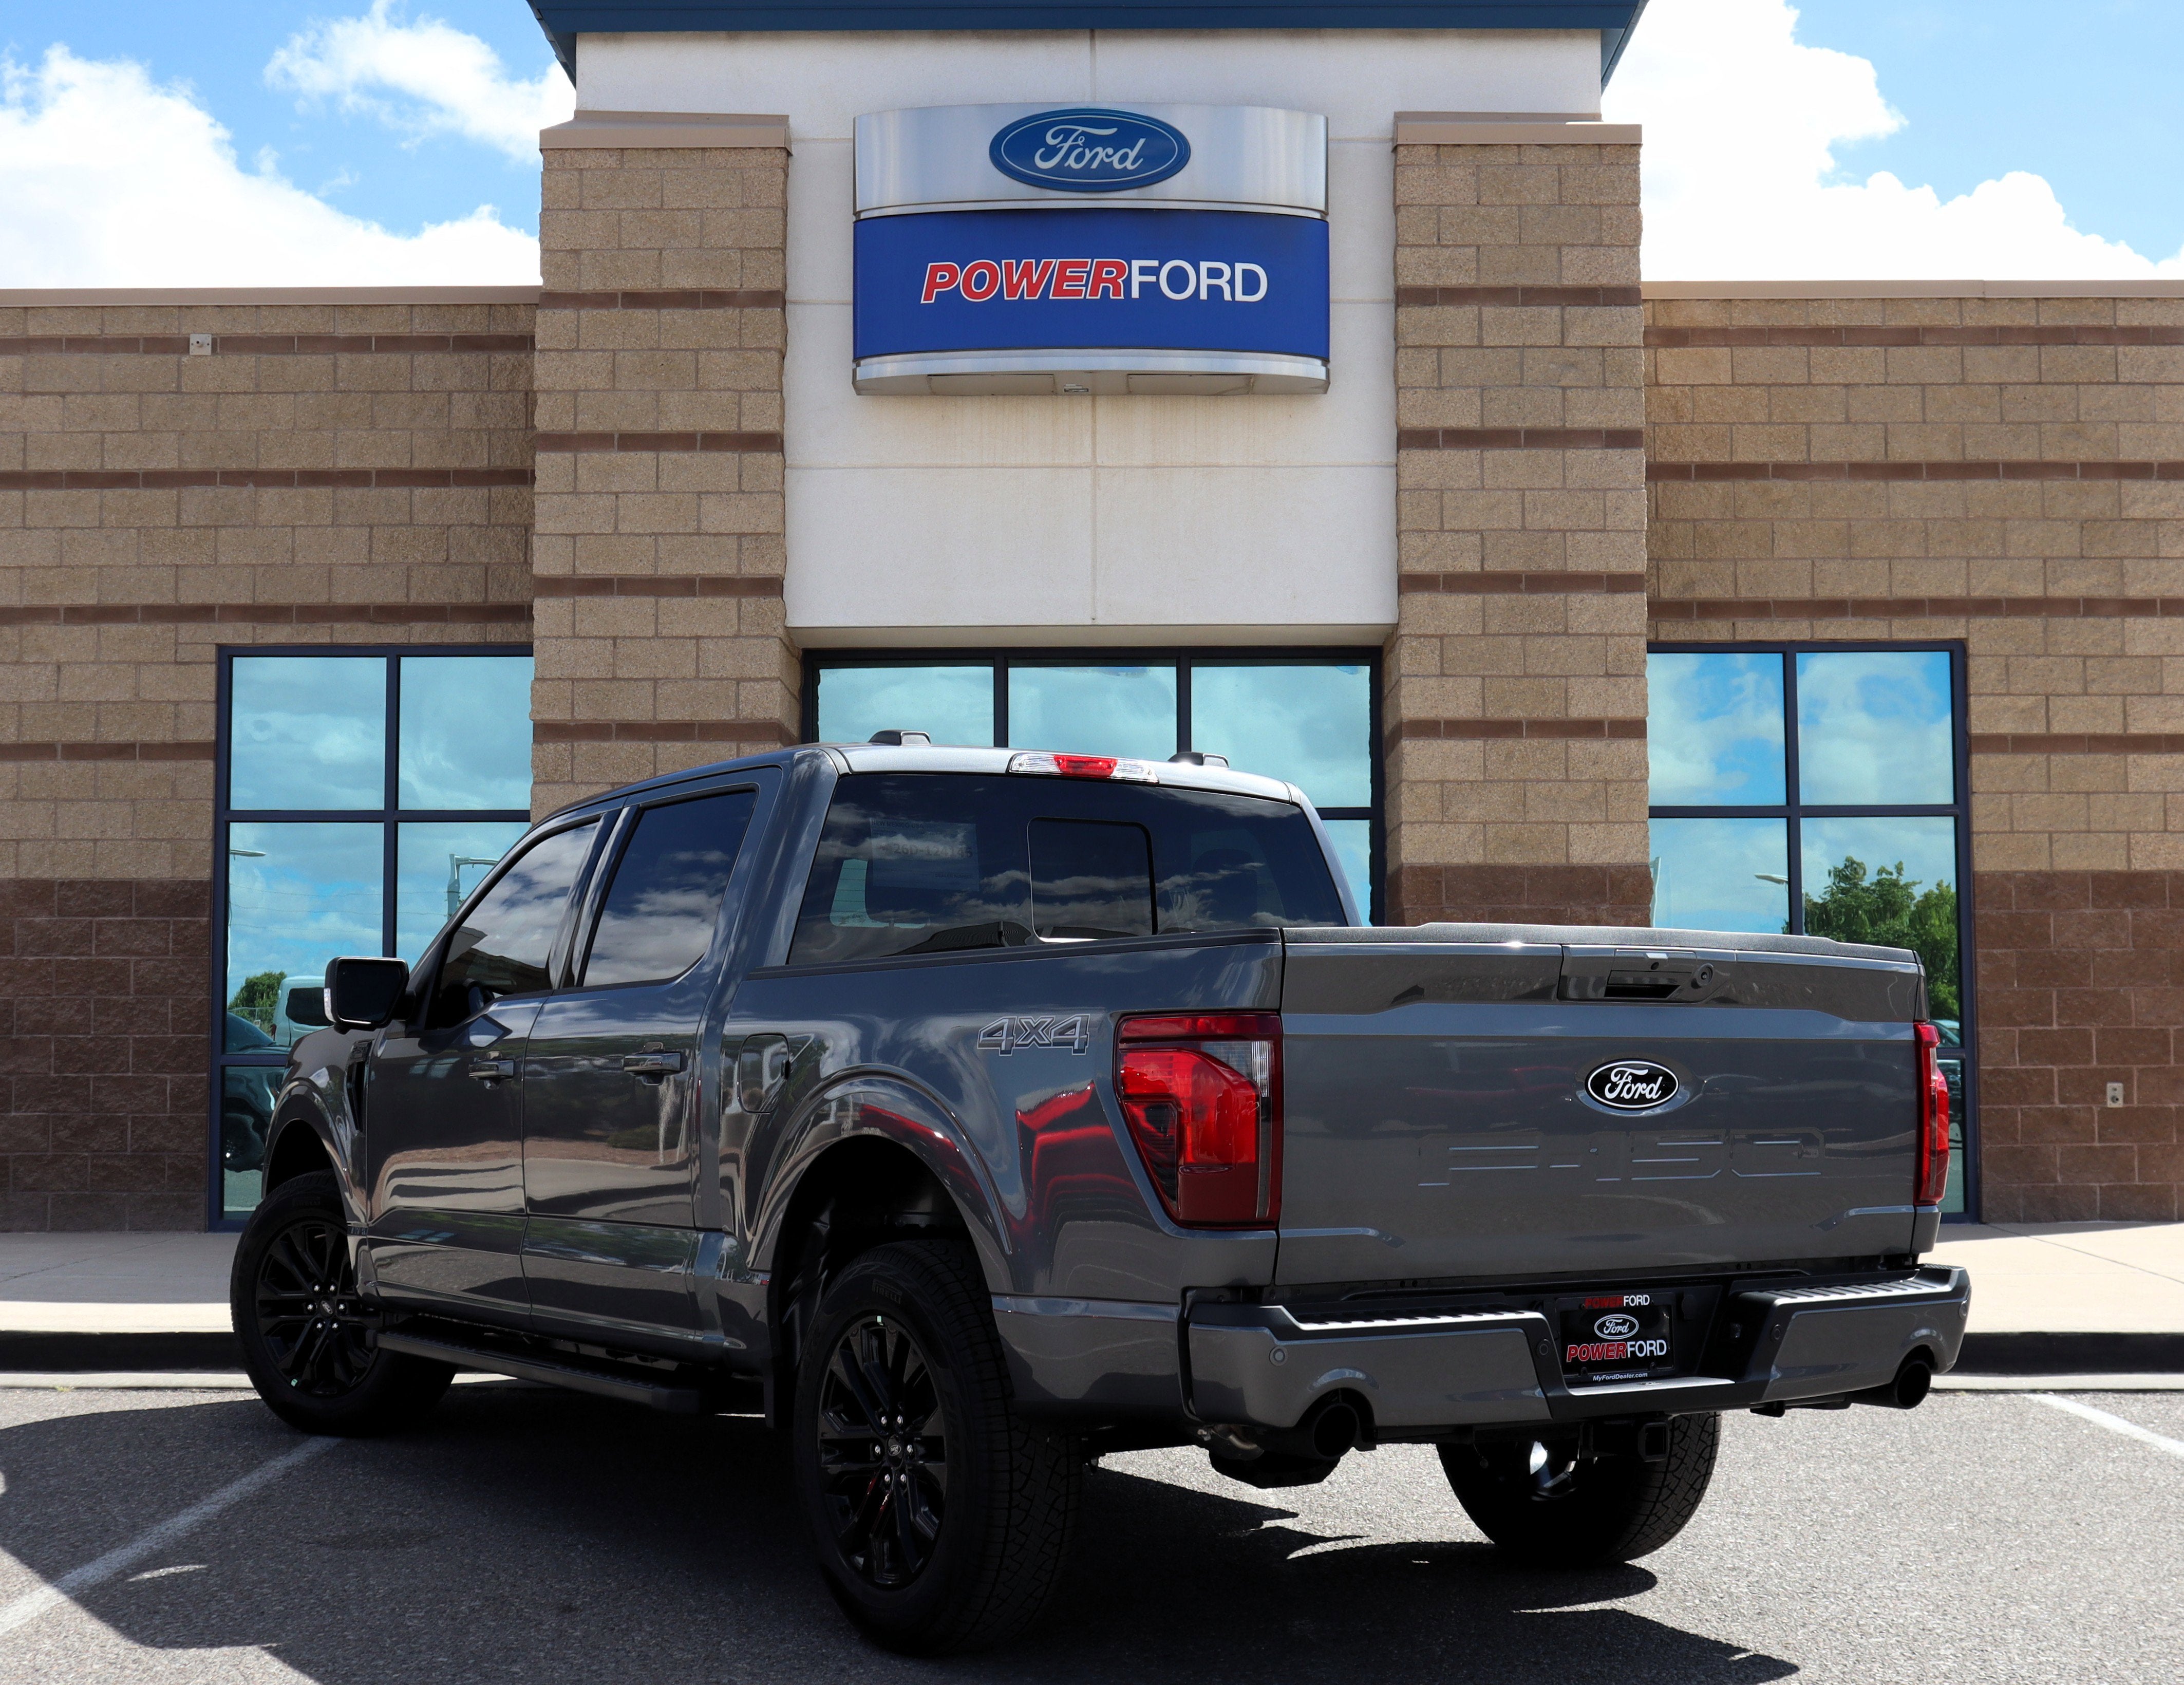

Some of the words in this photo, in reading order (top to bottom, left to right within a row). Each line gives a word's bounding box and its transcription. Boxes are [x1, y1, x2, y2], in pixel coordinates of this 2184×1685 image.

[1034, 125, 1146, 170] Ford
[920, 258, 1268, 304] POWERFORD
[1604, 1067, 1664, 1100] Ford
[872, 1278, 902, 1305] PIRELLI
[1585, 1295, 1650, 1309] POWERFORD
[1603, 1319, 1629, 1334] Ford
[1566, 1339, 1667, 1363] POWERFORD
[1593, 1372, 1648, 1382] MyFordDealer.com
